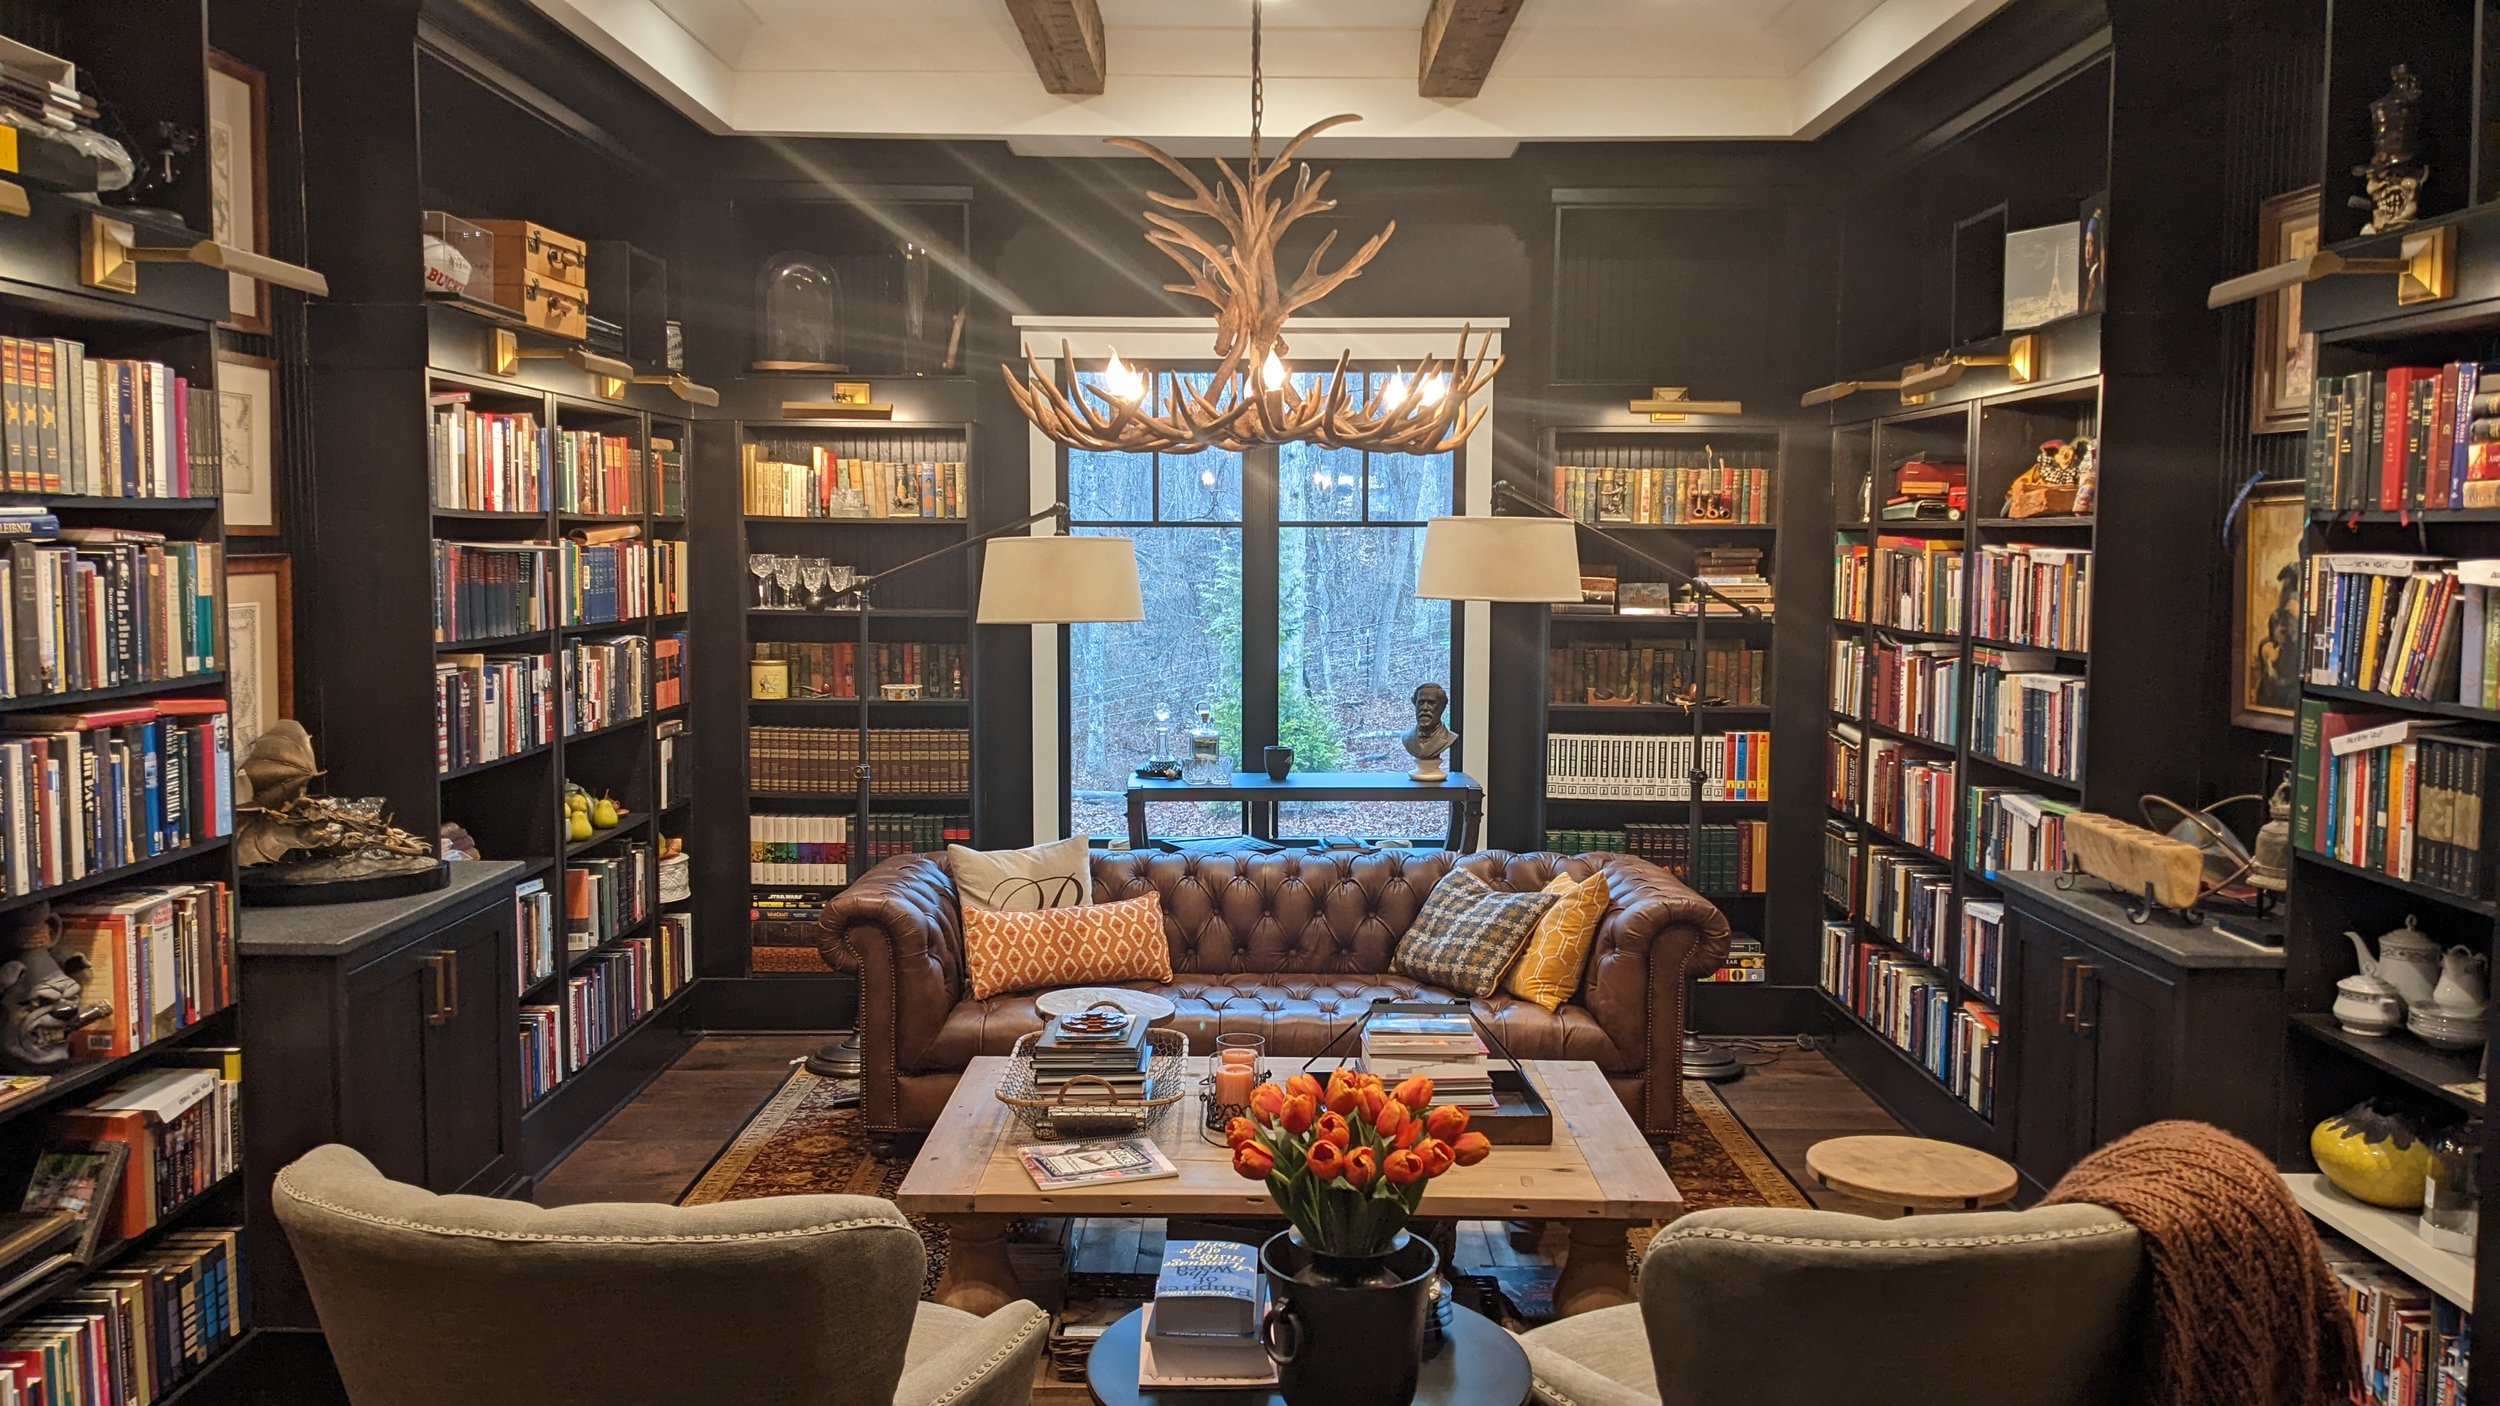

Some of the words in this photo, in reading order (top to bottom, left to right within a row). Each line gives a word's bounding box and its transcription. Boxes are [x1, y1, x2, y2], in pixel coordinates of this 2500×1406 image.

[166, 758, 180, 821] CHURCHILL
[1194, 1241, 1242, 1251] World
[1162, 1258, 1239, 1268] Language
[1188, 1252, 1247, 1264] History
[1179, 1270, 1210, 1280] the
[1198, 1276, 1218, 1286] of
[1158, 1282, 1253, 1297] Empires
